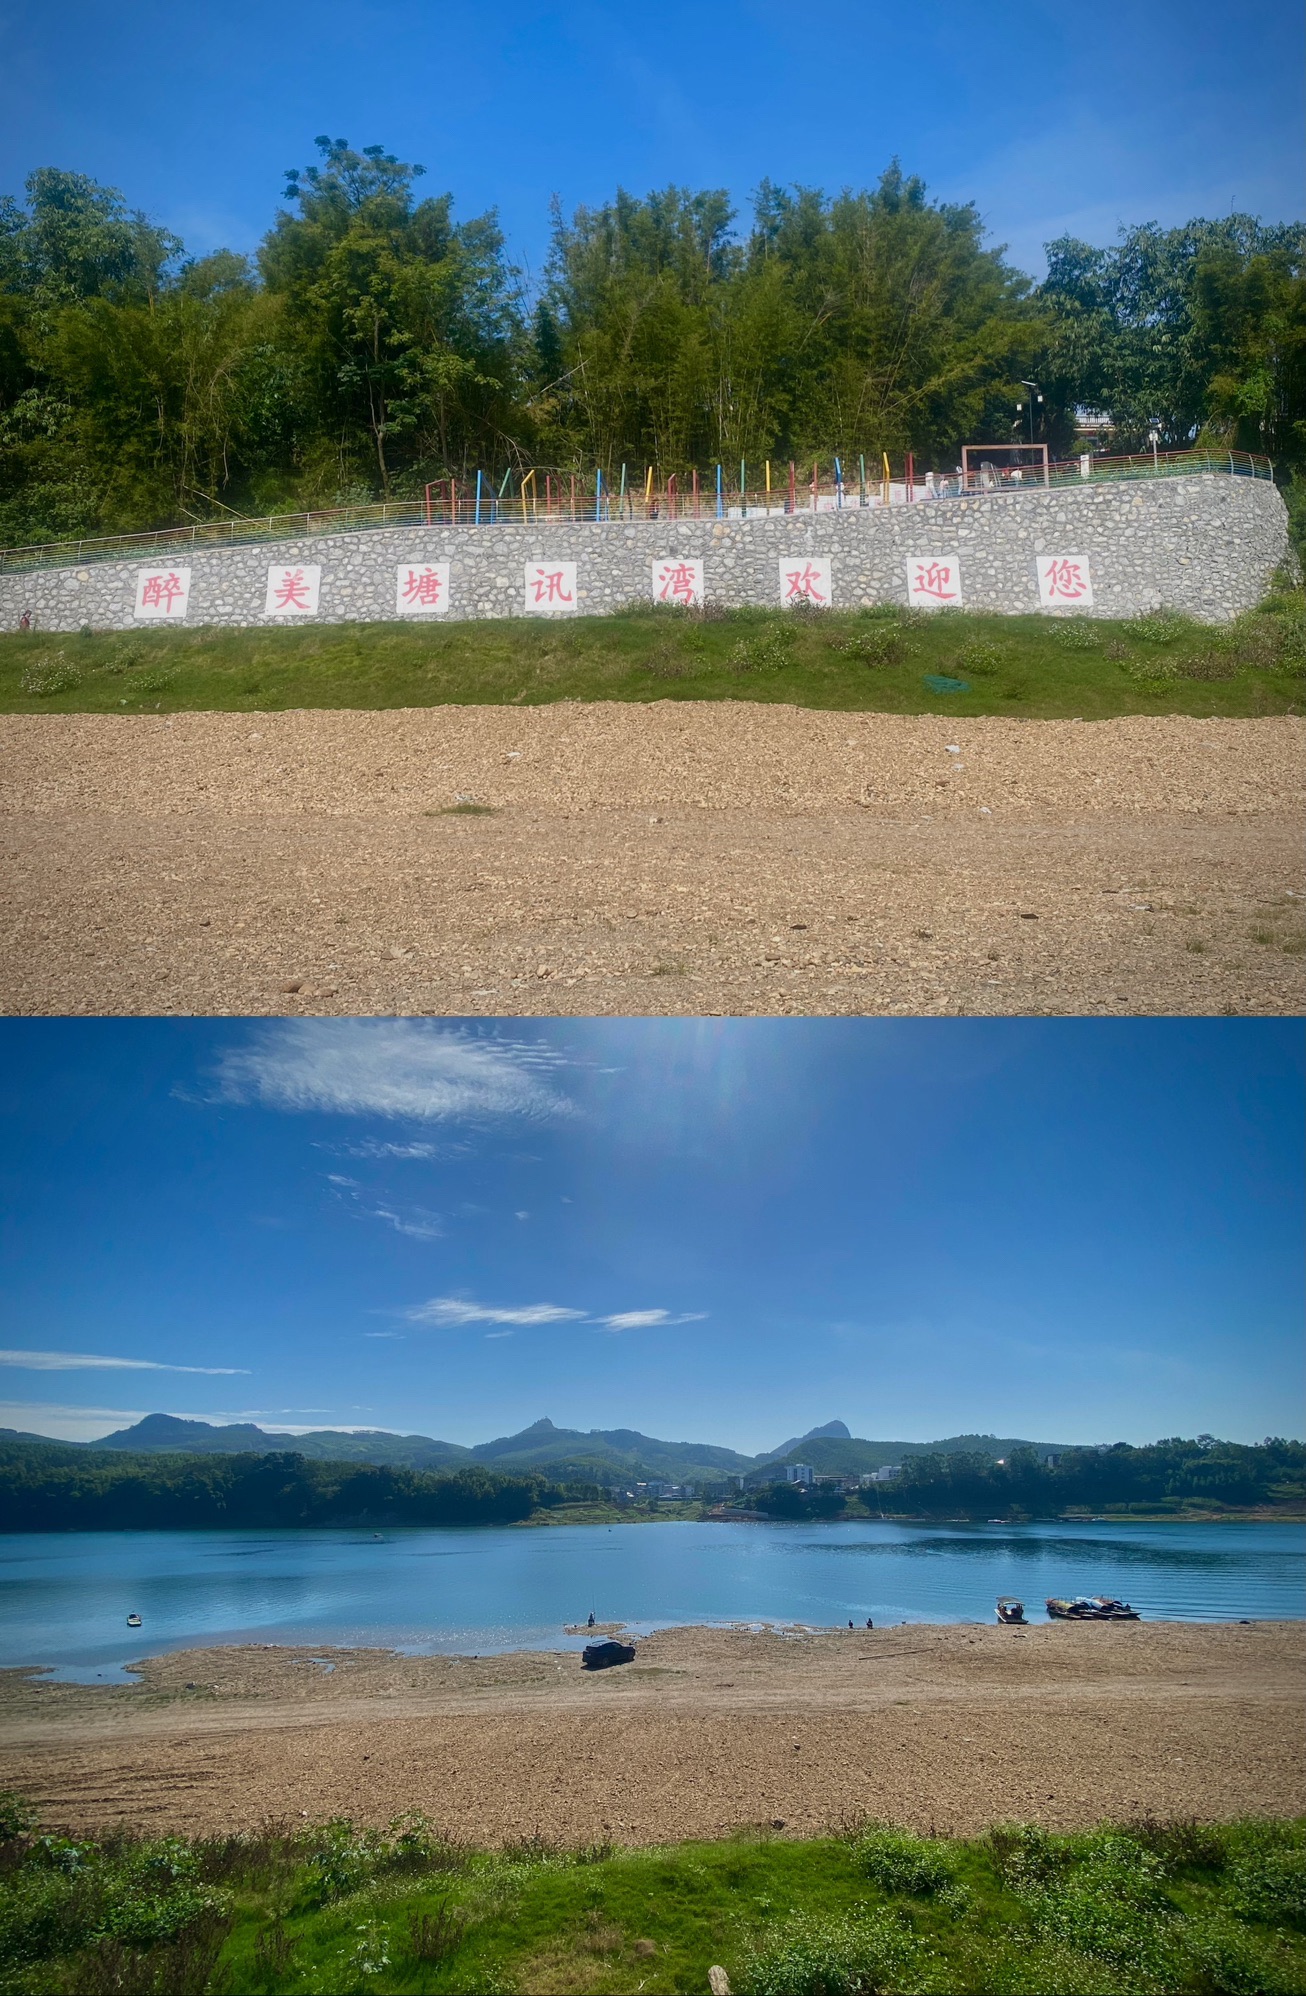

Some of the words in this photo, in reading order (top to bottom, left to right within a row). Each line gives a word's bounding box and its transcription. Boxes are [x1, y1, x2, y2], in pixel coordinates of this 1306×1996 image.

[141, 559, 1088, 614] 醉美塘讯湾欢迎您
